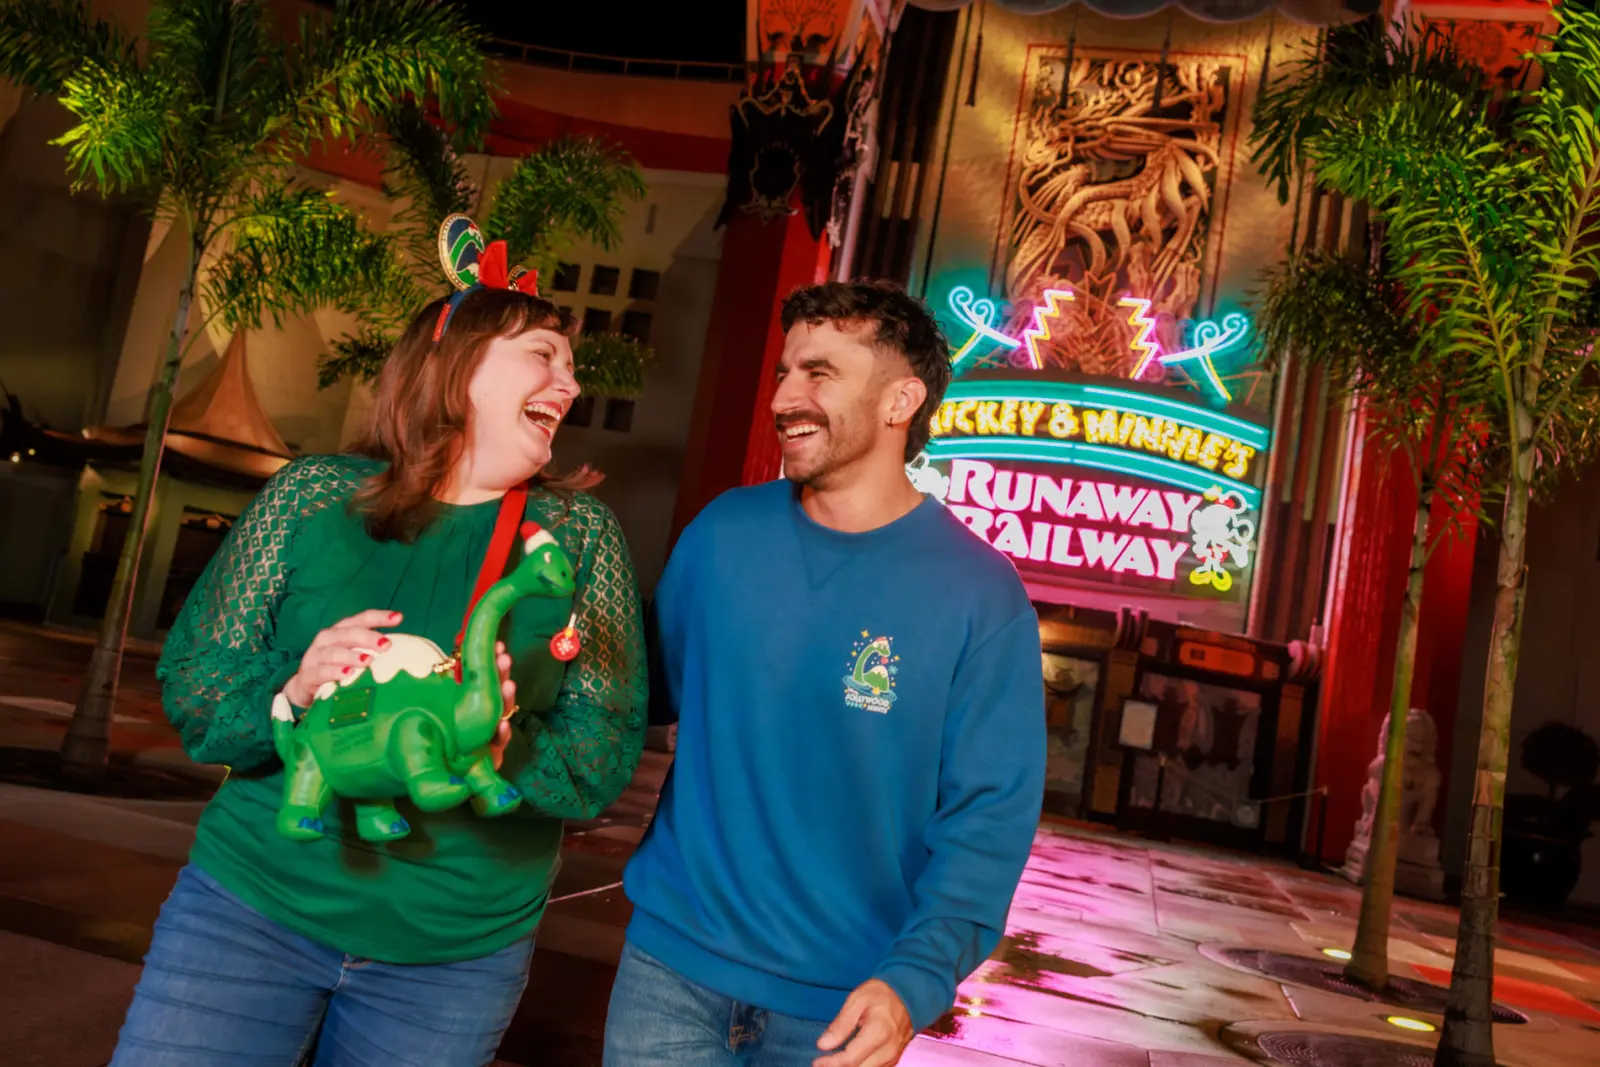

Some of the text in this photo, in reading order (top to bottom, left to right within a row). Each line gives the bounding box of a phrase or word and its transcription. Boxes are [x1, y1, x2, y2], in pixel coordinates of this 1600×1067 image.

[1049, 403, 1079, 438] &
[1082, 409, 1256, 479] MINNIE'S
[948, 458, 1202, 533] RUNAWAY
